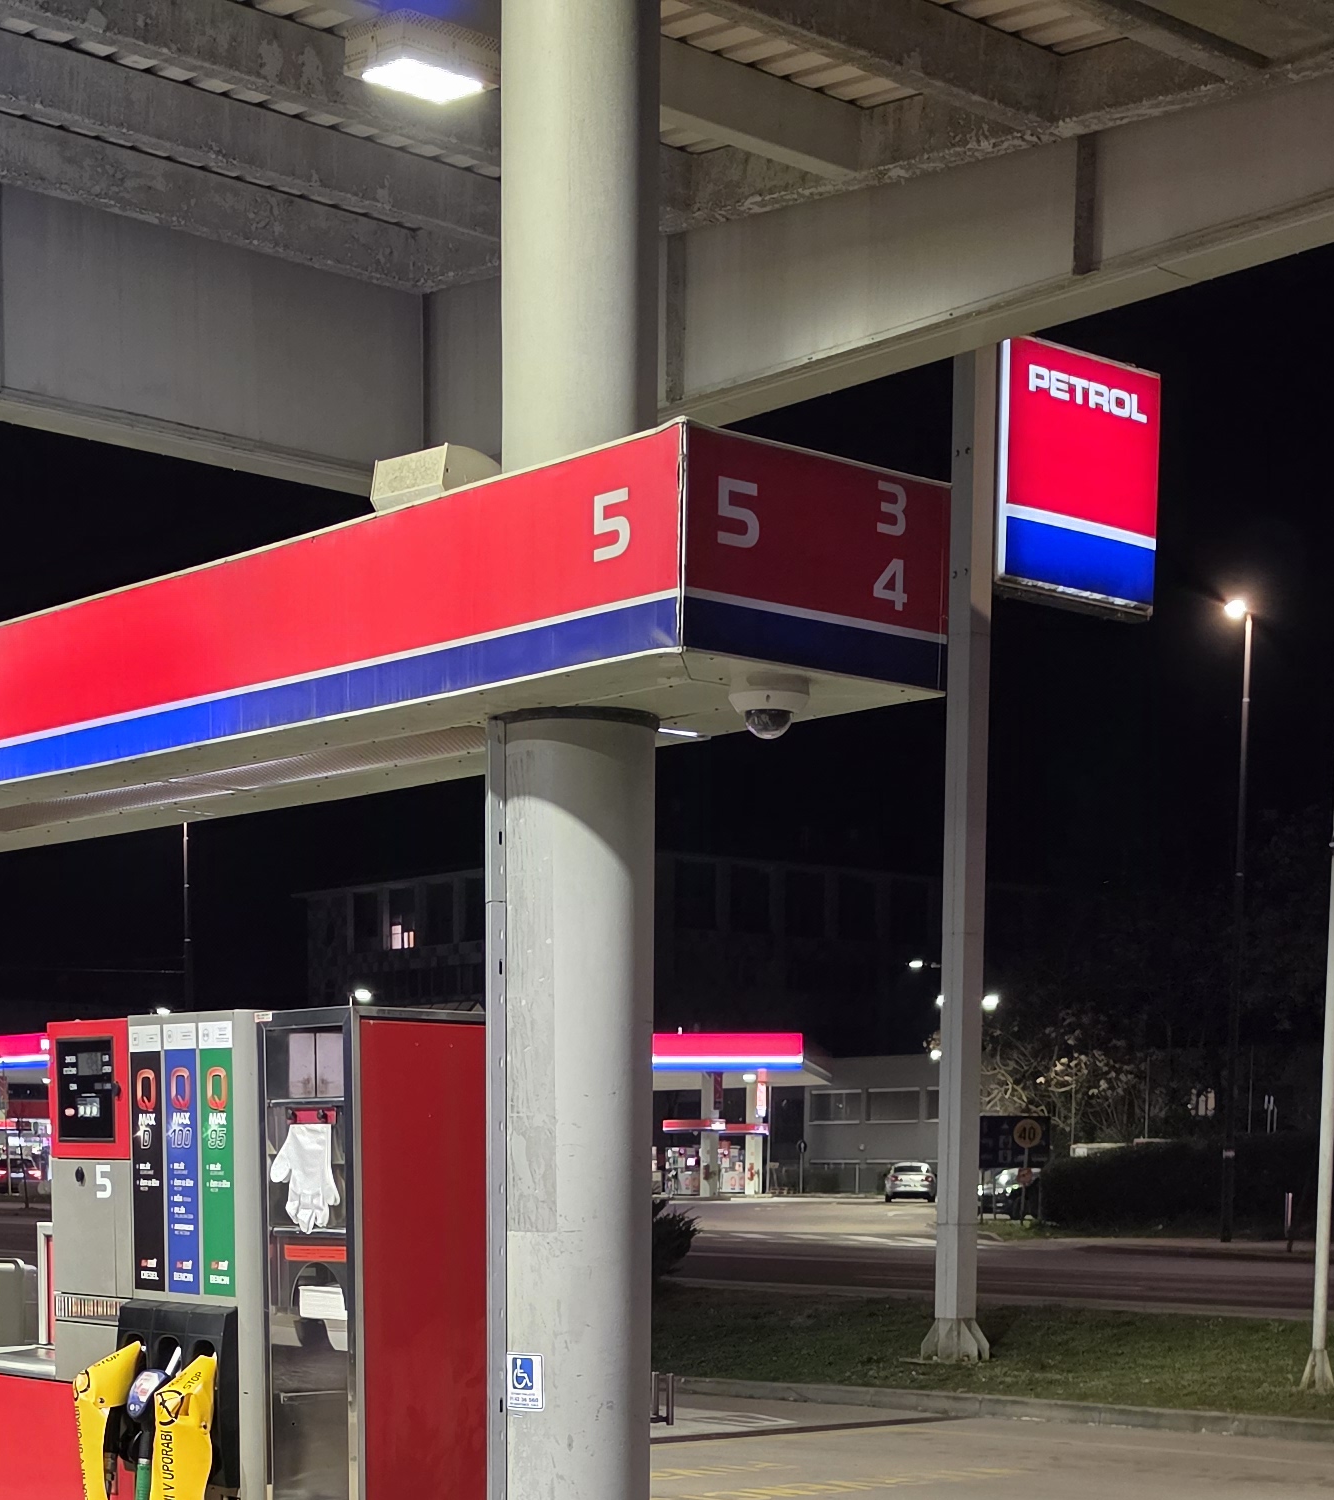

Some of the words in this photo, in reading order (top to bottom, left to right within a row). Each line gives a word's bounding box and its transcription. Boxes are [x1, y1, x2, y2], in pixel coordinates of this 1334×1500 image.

[1028, 363, 1149, 424] PETROL
[592, 487, 631, 563] 5
[716, 476, 760, 550] 5
[876, 480, 907, 537] 3
[872, 558, 908, 611] 4
[169, 1127, 193, 1149] 100
[207, 1127, 227, 1149] 95
[1018, 1126, 1037, 1145] 40
[95, 1164, 112, 1199] 5
[182, 1371, 202, 1390] STOP
[160, 1430, 175, 1481] UPORABI
[162, 1482, 175, 1494] V
